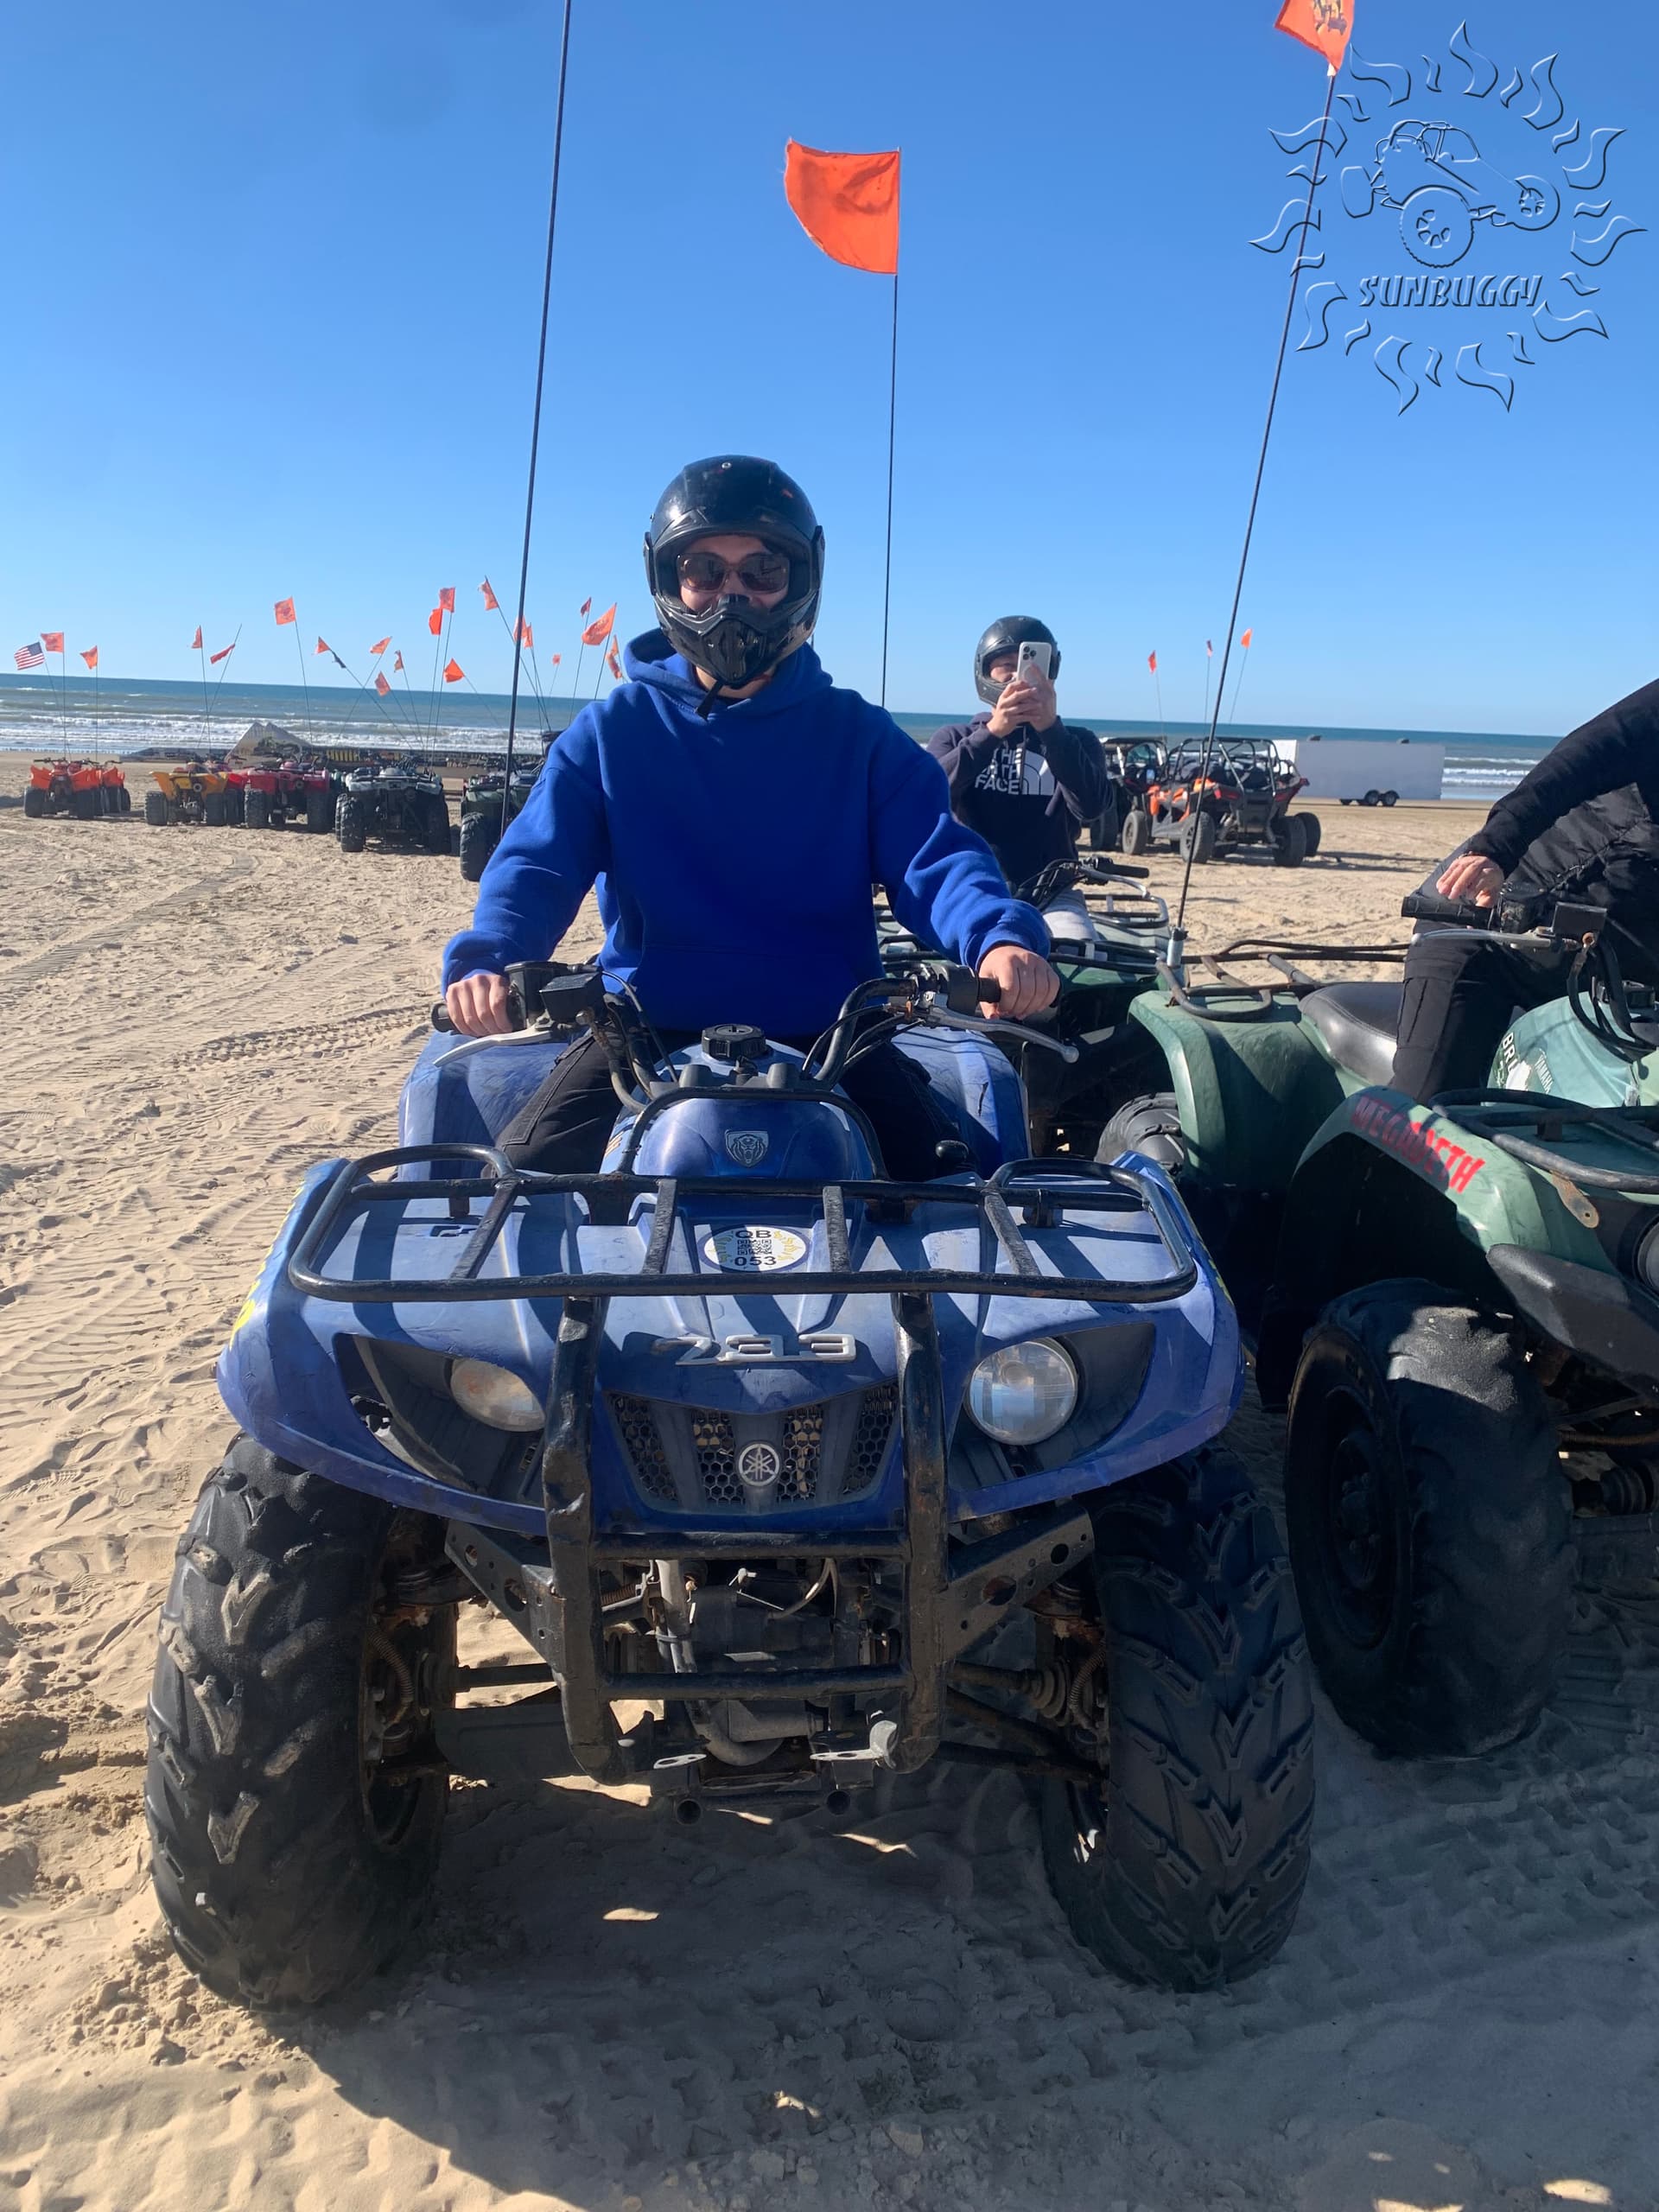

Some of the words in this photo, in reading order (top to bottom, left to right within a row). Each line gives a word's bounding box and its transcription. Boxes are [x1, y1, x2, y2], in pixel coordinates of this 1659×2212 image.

[974, 773, 1020, 795] FACE
[734, 1230, 772, 1239] QB
[734, 1256, 777, 1267] 053
